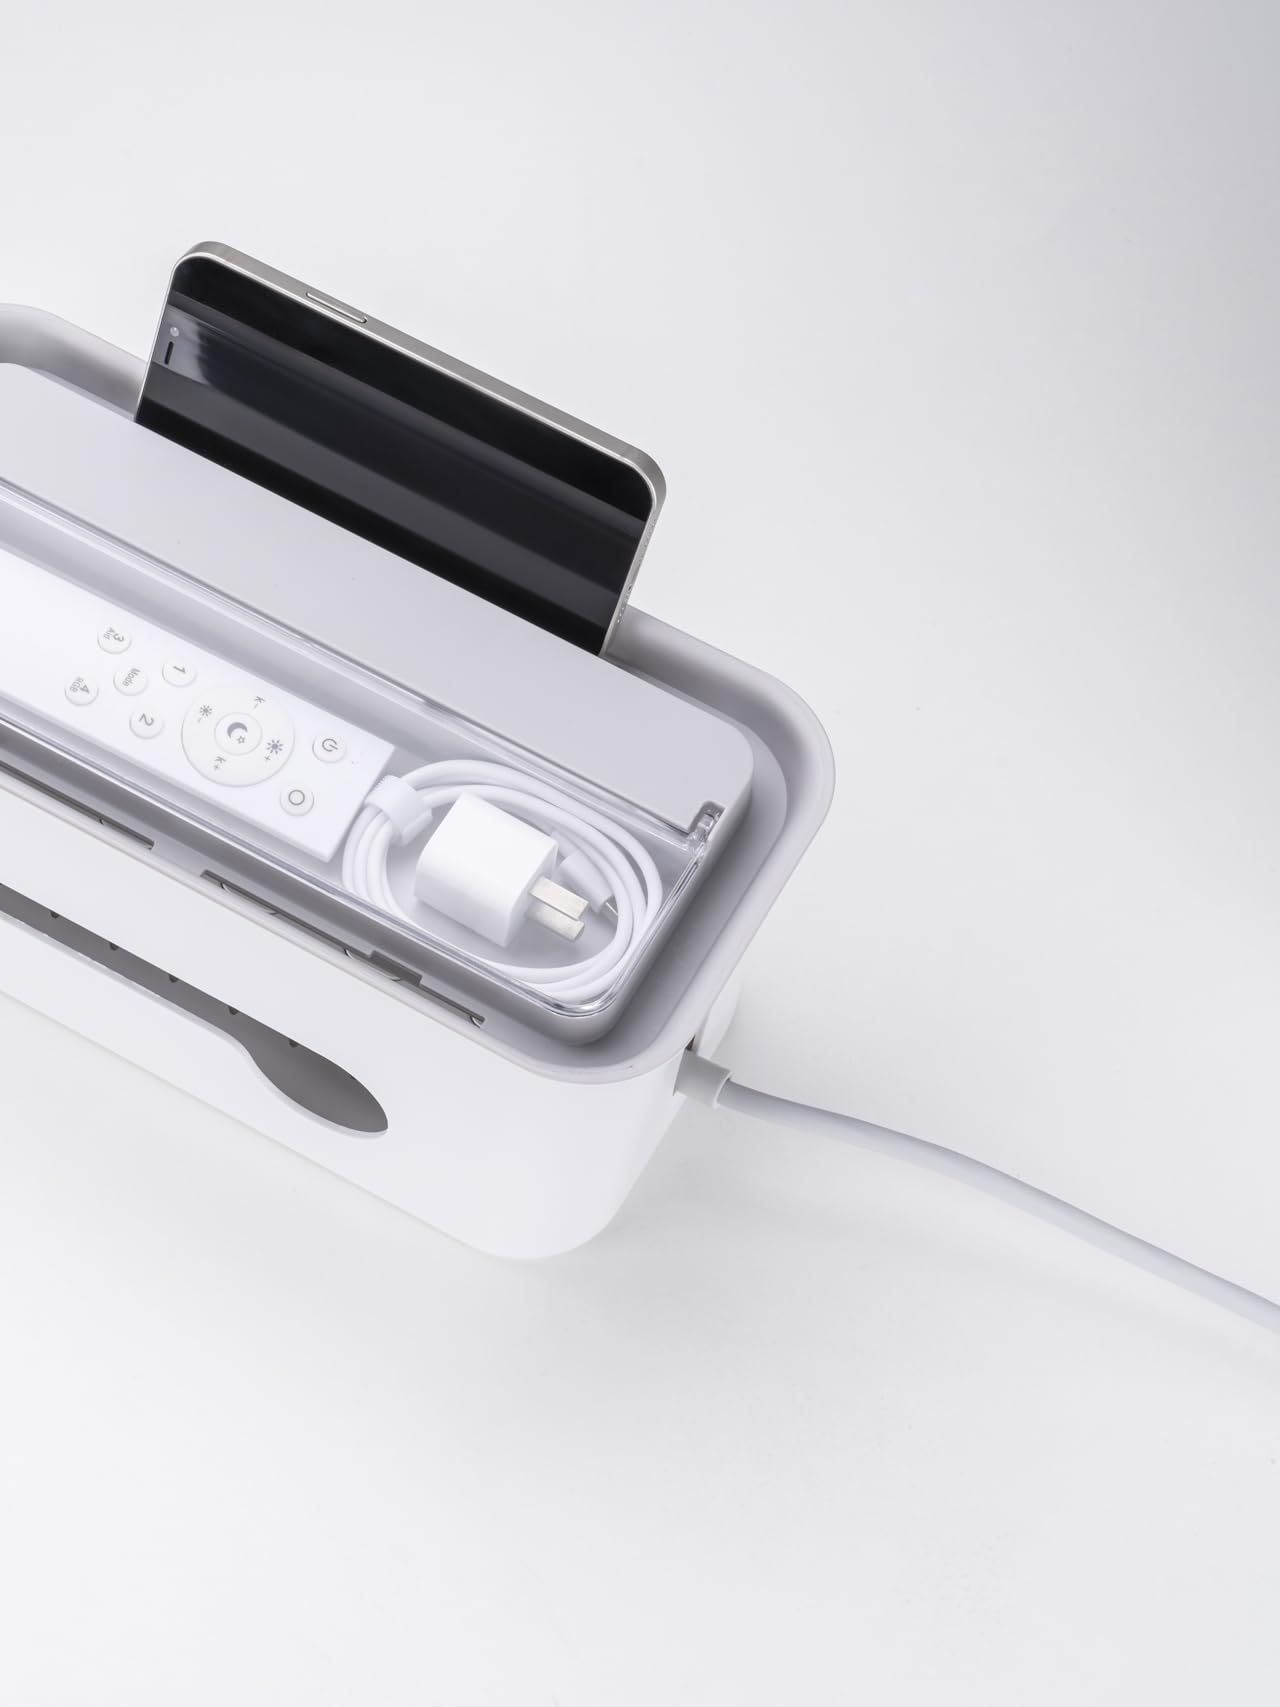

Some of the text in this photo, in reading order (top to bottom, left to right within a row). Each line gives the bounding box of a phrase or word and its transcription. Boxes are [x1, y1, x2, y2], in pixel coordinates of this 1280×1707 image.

[113, 630, 124, 642] 3
[123, 669, 140, 686] Mode
[70, 677, 84, 692] RGB
[79, 684, 89, 694] 4
[139, 713, 154, 726] 2
